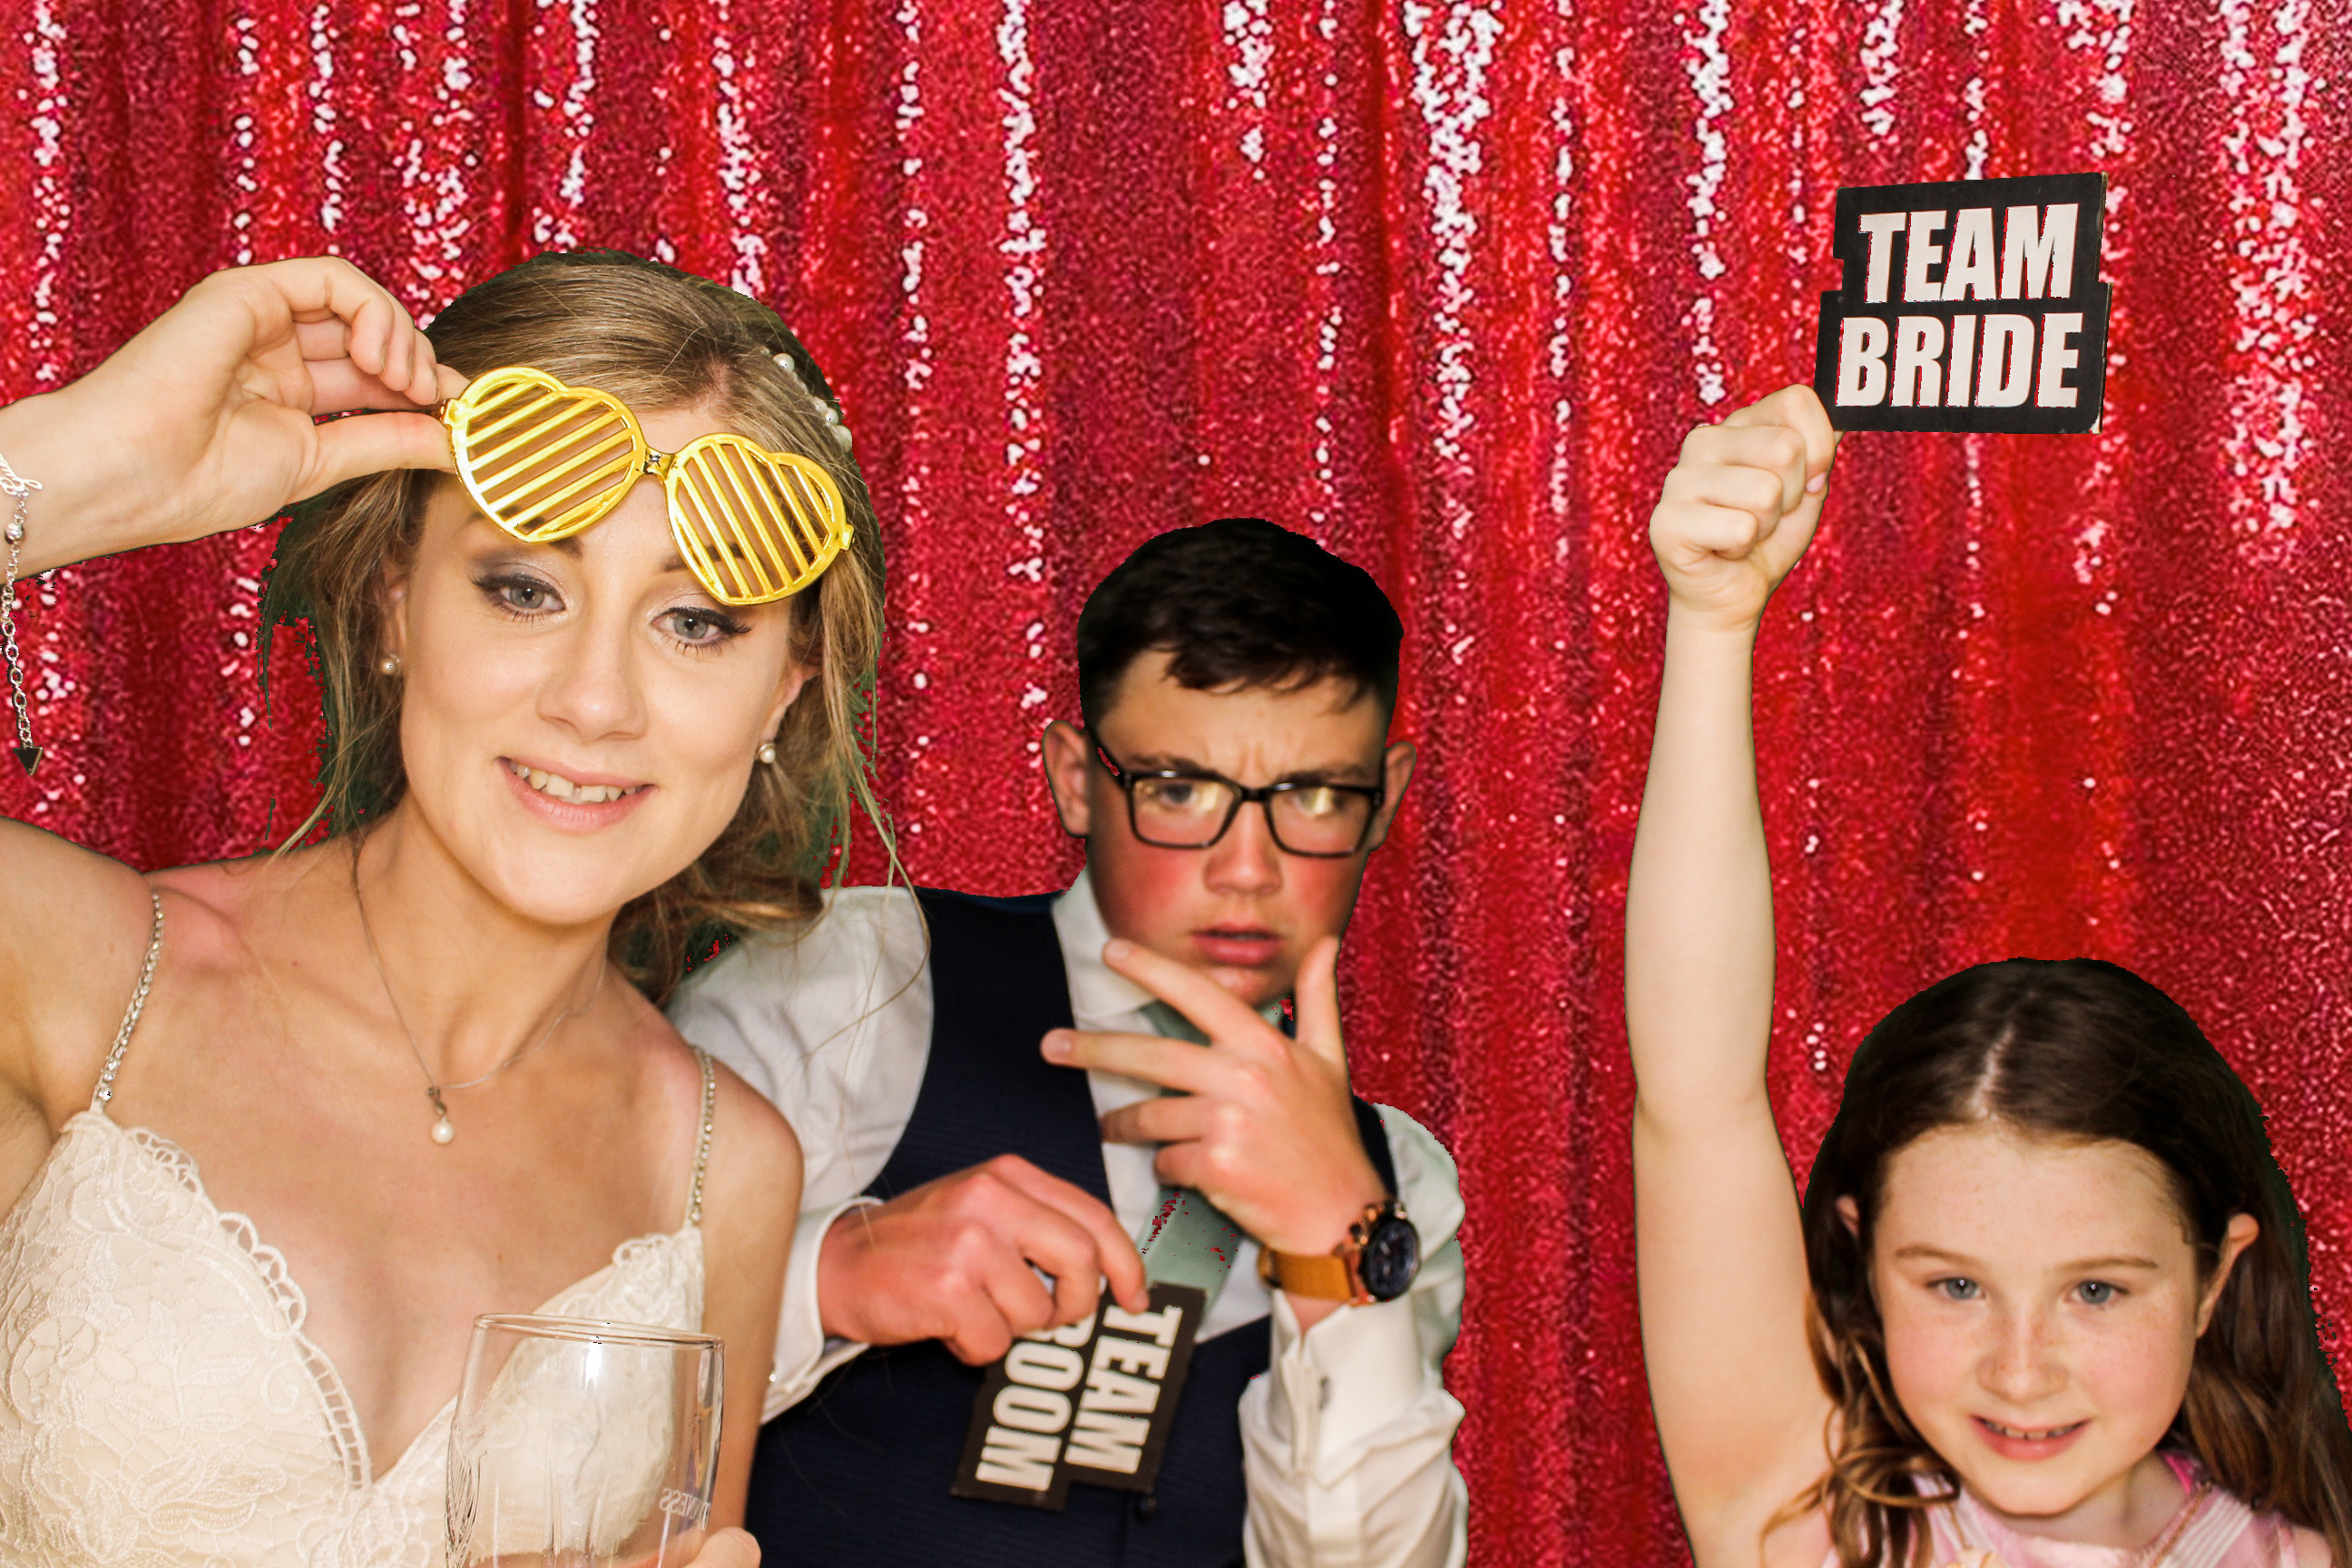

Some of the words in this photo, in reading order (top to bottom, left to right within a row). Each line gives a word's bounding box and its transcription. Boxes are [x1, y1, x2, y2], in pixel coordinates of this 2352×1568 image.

[1858, 203, 2079, 303] TEAM
[1835, 312, 2083, 408] BRIDE
[1063, 1304, 1183, 1475] TEAM
